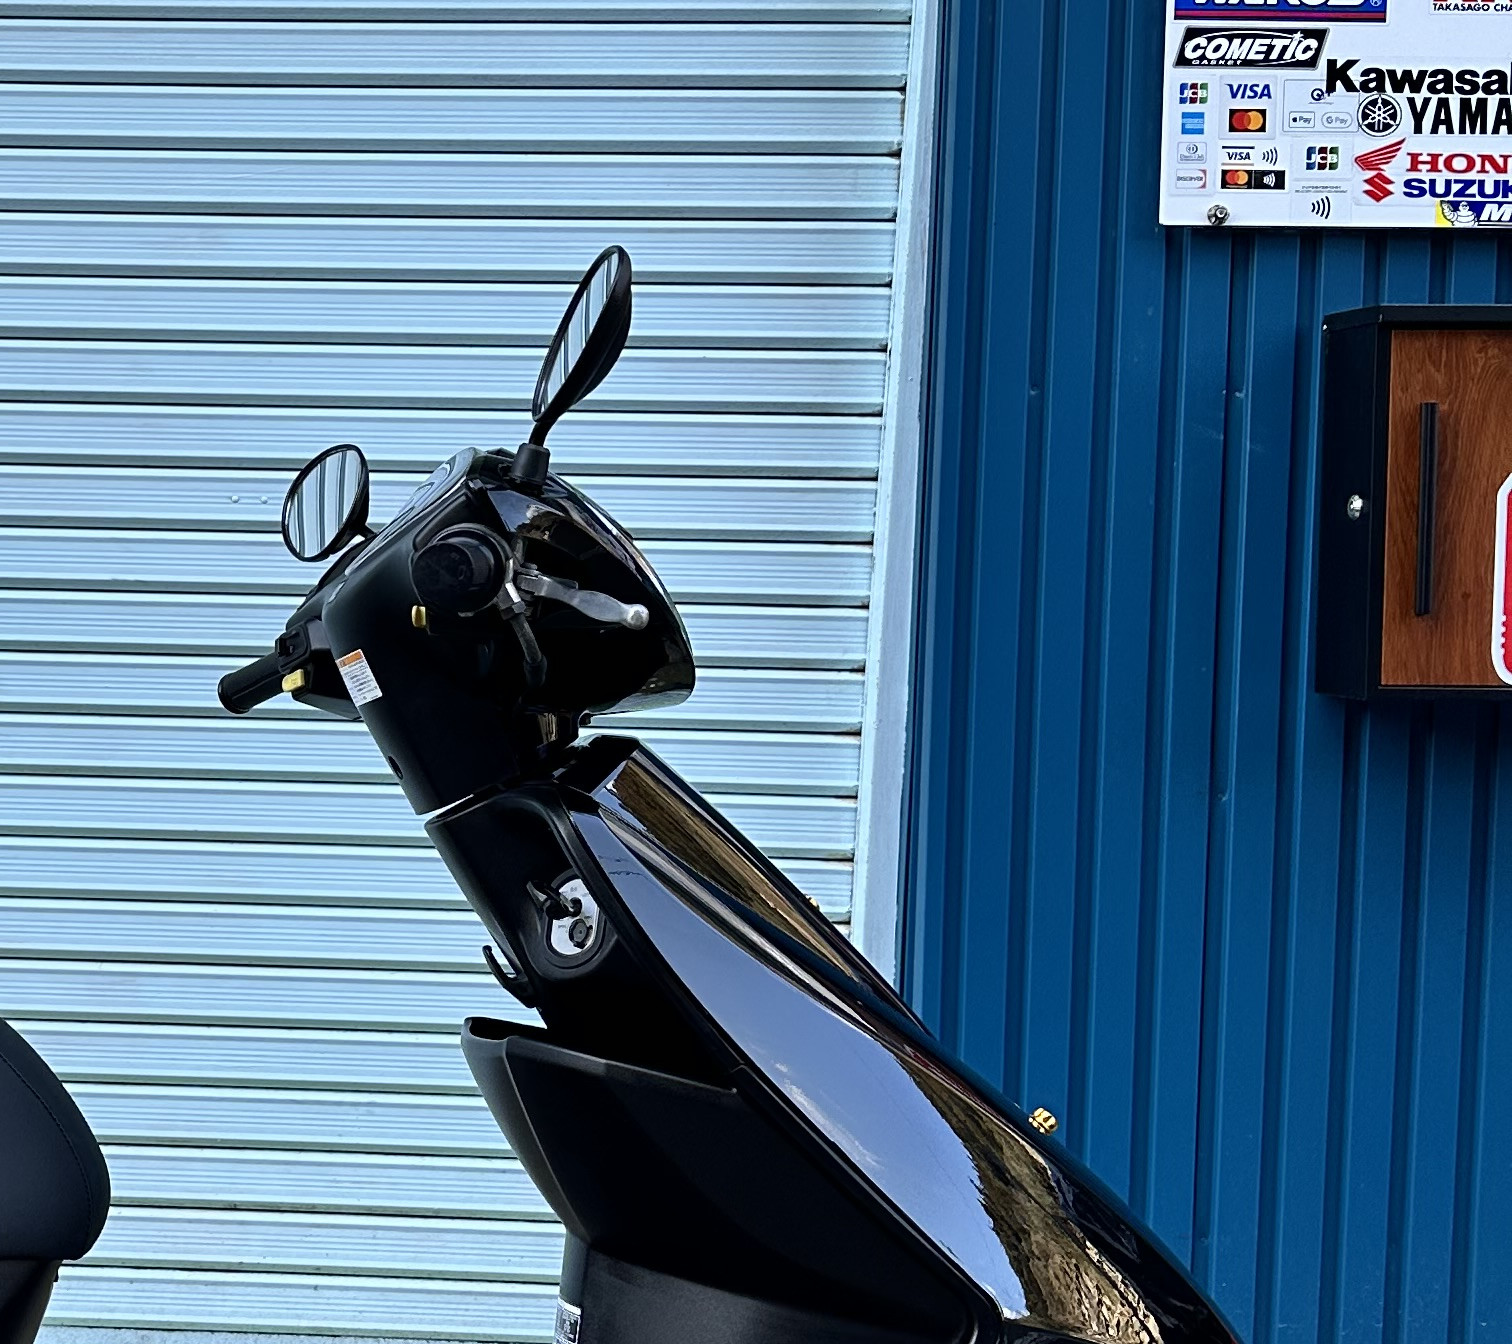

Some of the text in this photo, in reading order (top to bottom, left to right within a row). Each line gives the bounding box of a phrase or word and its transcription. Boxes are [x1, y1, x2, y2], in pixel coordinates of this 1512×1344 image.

[1433, 3, 1490, 12] TAKASAGO
[1184, 35, 1319, 61] COMETIC
[1326, 59, 1512, 96] Kawasa
[1224, 83, 1272, 99] VISA
[1406, 97, 1512, 136] YAMA
[1226, 151, 1251, 161] VISA
[1406, 152, 1512, 174] HON
